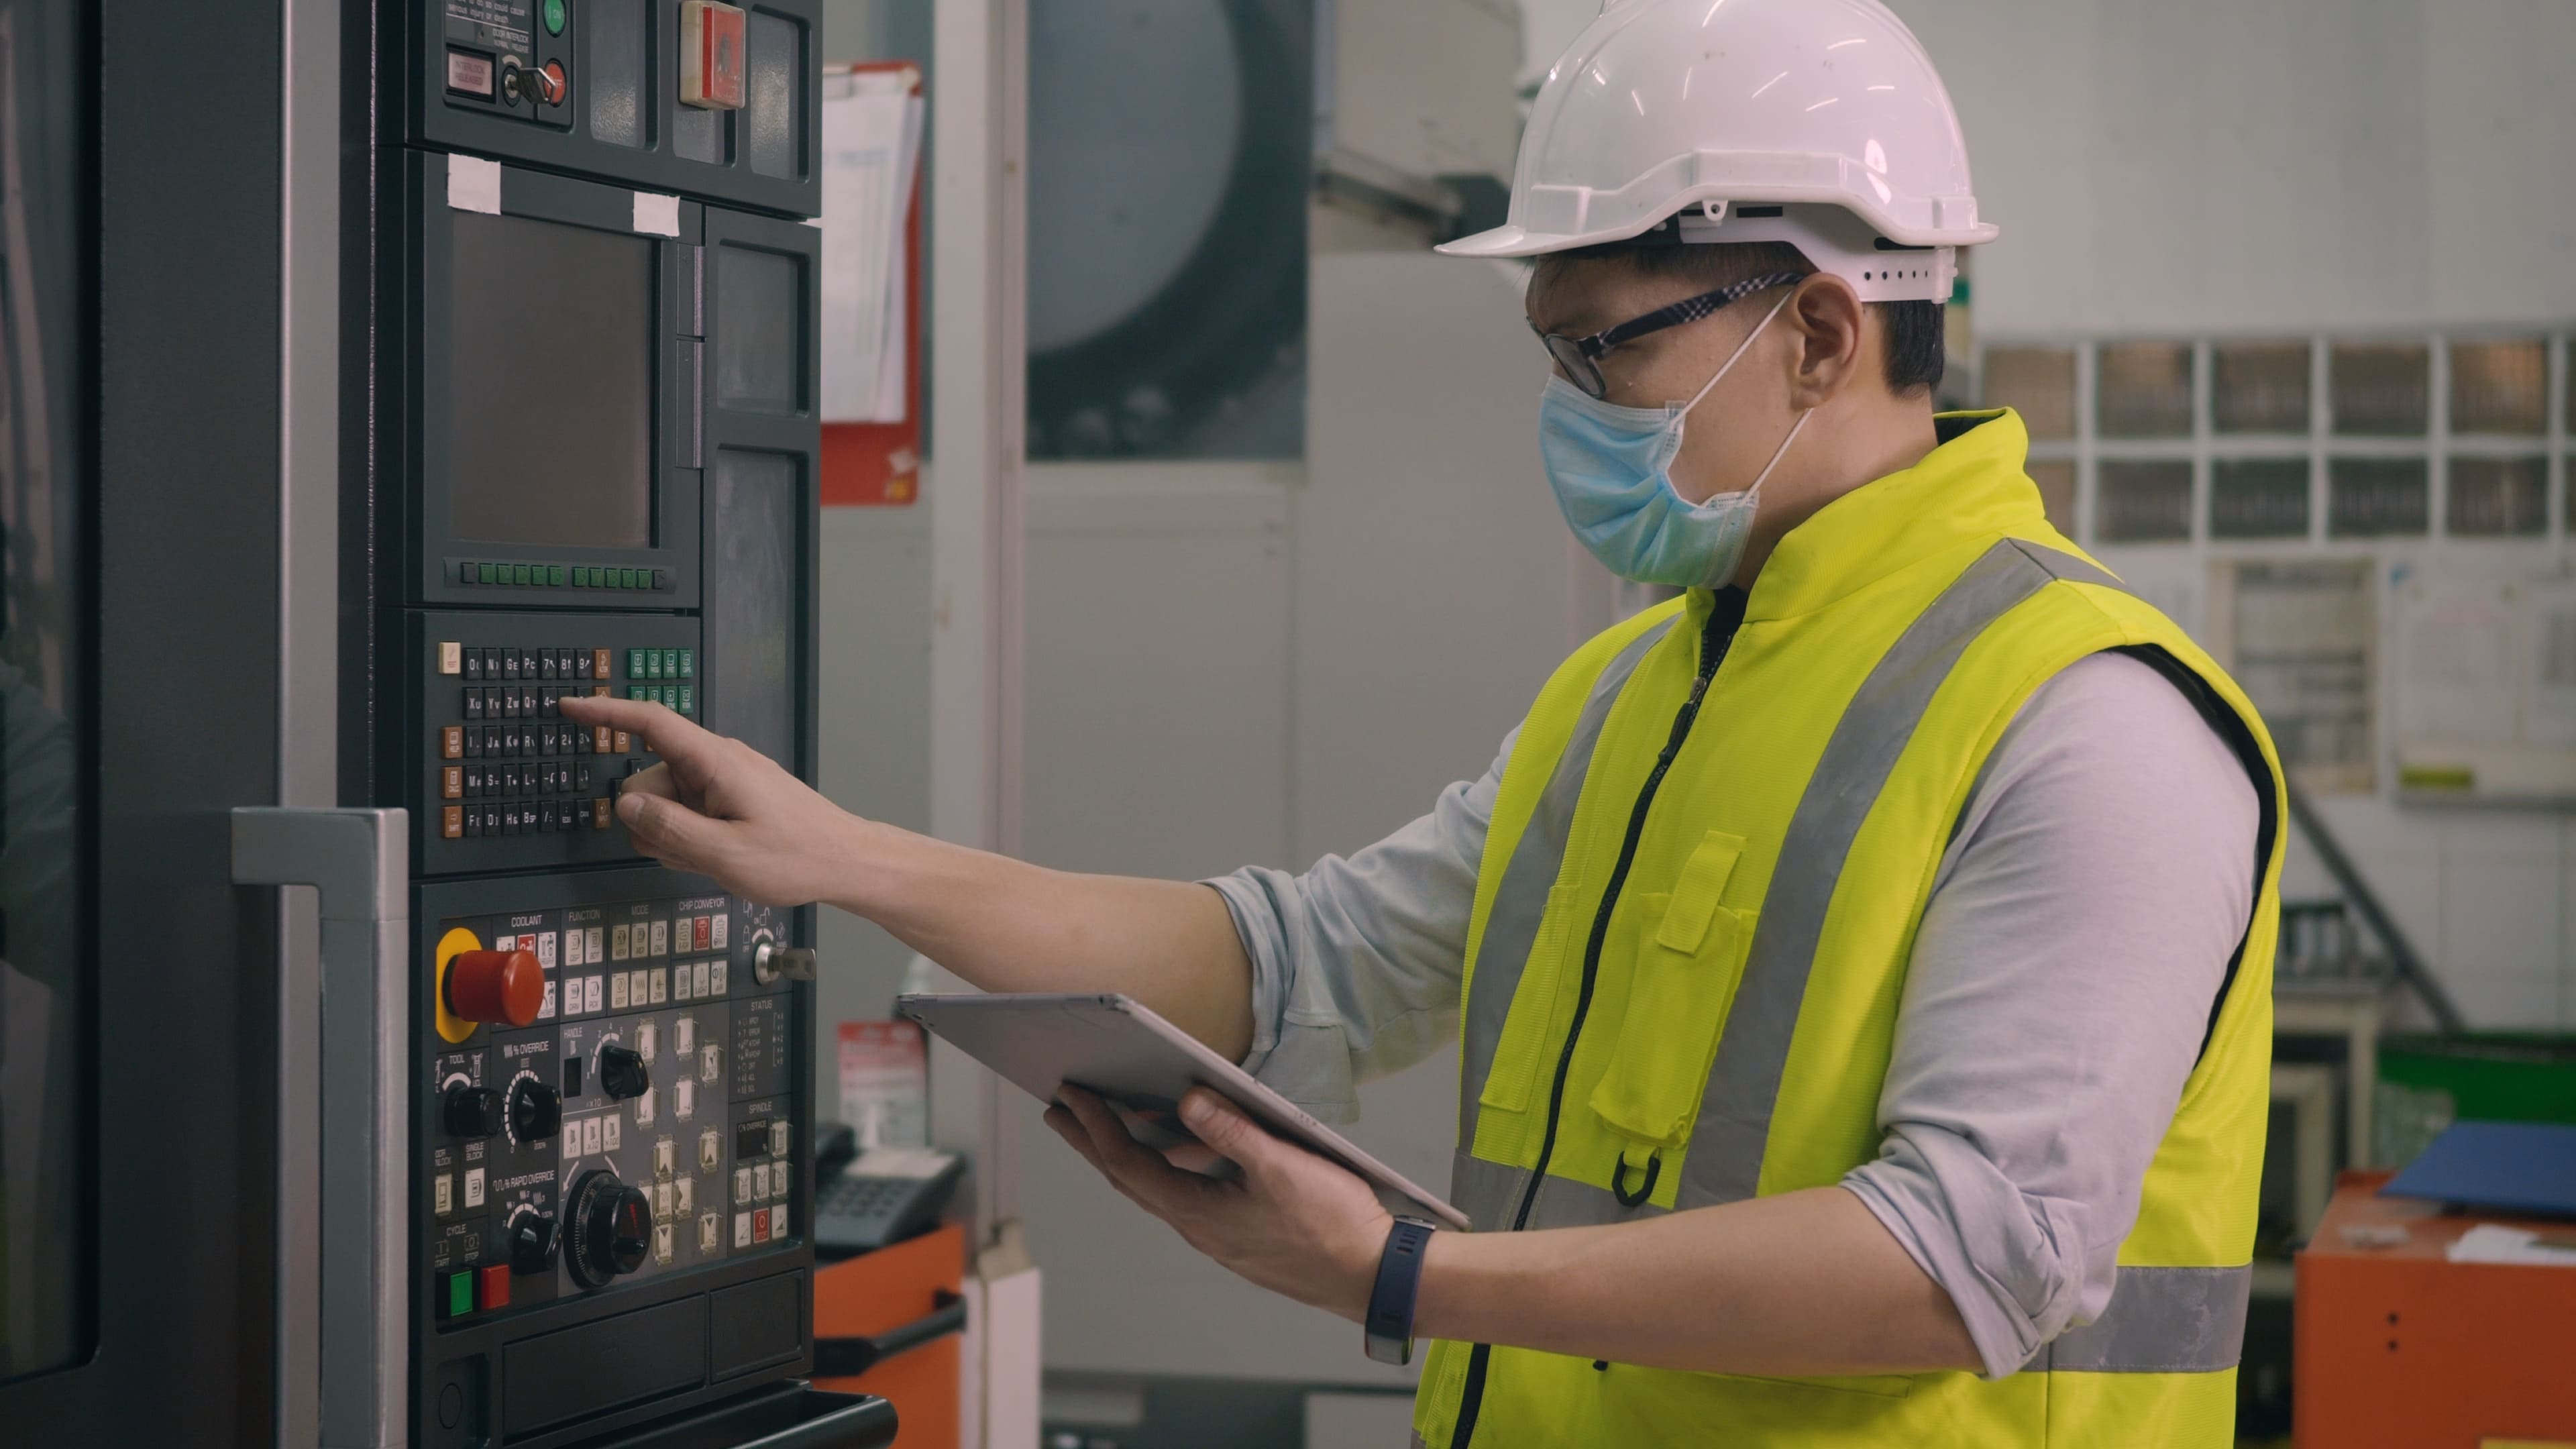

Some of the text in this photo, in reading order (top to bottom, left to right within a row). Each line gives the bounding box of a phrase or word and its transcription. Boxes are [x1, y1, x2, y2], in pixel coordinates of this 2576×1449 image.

[448, 4, 467, 14] serious
[470, 8, 484, 19] injury
[494, 3, 508, 12] could
[510, 7, 525, 16] cause
[493, 28, 529, 43] DOOR INTERLOCK
[456, 61, 484, 75] INTERLOCK
[631, 904, 649, 916] MODE
[678, 898, 724, 911] CHIP CONVEYOR
[511, 914, 543, 927] COOLANT
[569, 910, 600, 922] FUNCTION
[751, 1000, 772, 1012] STATUS
[564, 1026, 583, 1038] HANDLE
[520, 1040, 549, 1055] OVERRIDE
[449, 1054, 465, 1065] TOOL
[749, 1101, 771, 1114] SPINDLE
[747, 1120, 767, 1130] OVERRIDE
[466, 1142, 484, 1152] SINGLE
[466, 1150, 484, 1161] BLOCK
[511, 1175, 527, 1187] RAPID
[528, 1170, 555, 1184] OVERRIDE
[445, 1224, 467, 1237] CYCLE
[464, 1251, 479, 1262] STOP
